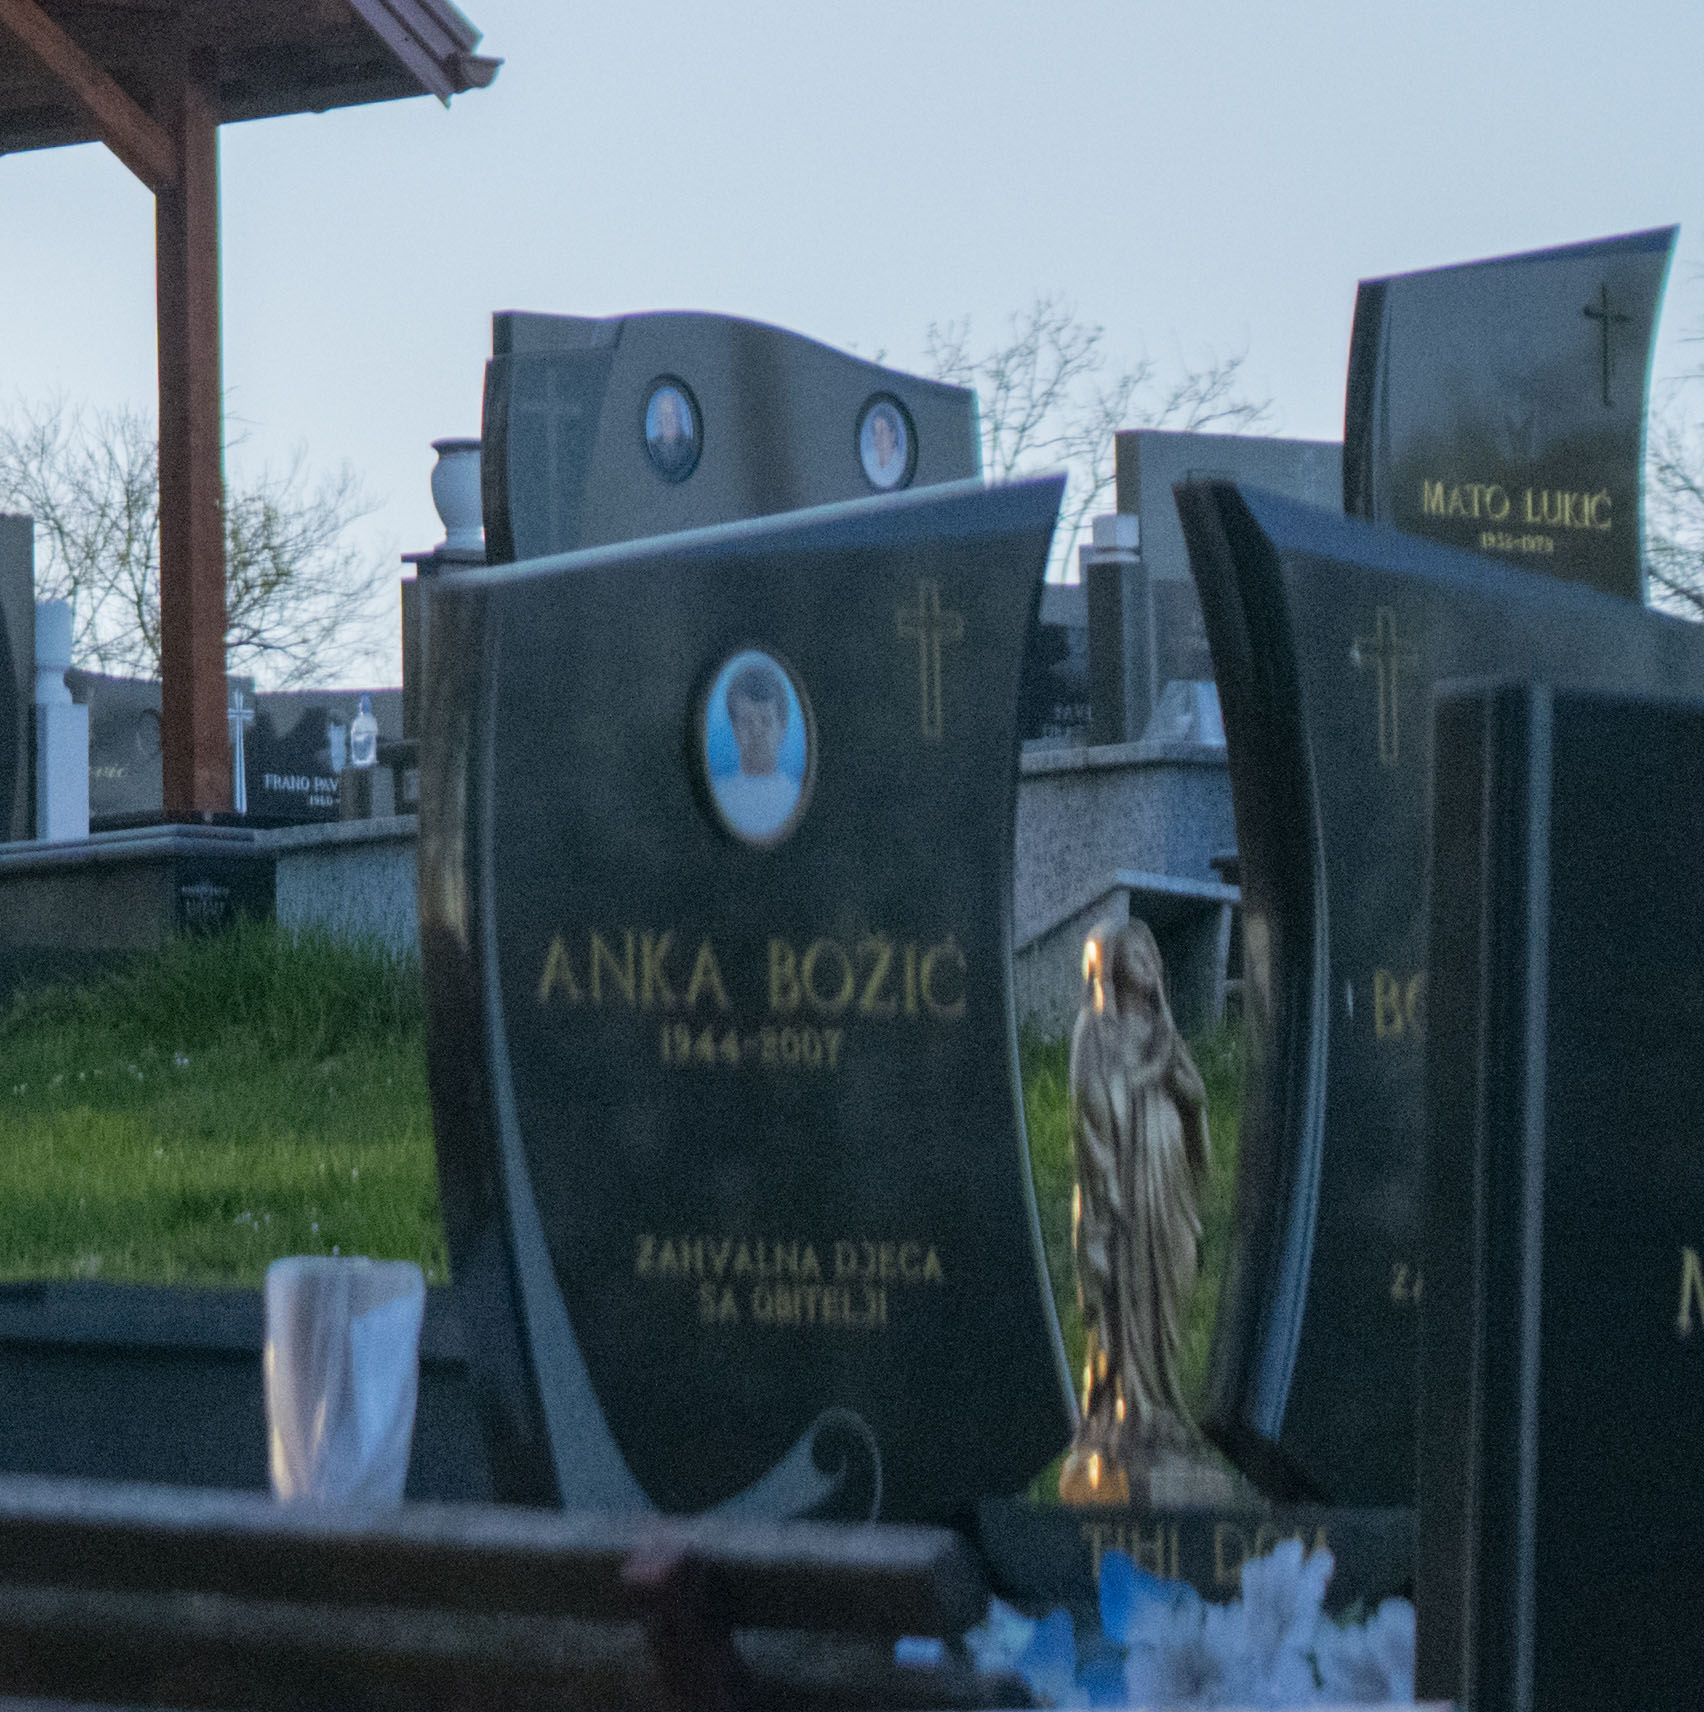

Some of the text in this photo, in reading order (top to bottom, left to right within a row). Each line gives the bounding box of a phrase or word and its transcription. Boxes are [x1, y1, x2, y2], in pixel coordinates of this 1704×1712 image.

[1422, 479, 1612, 532] MATO LUKIĆ
[536, 928, 967, 1019] ANKA BOŽIĆ
[635, 1234, 945, 1286] ZAHVALNA DJECA
[752, 1284, 888, 1329] OBITELJI
